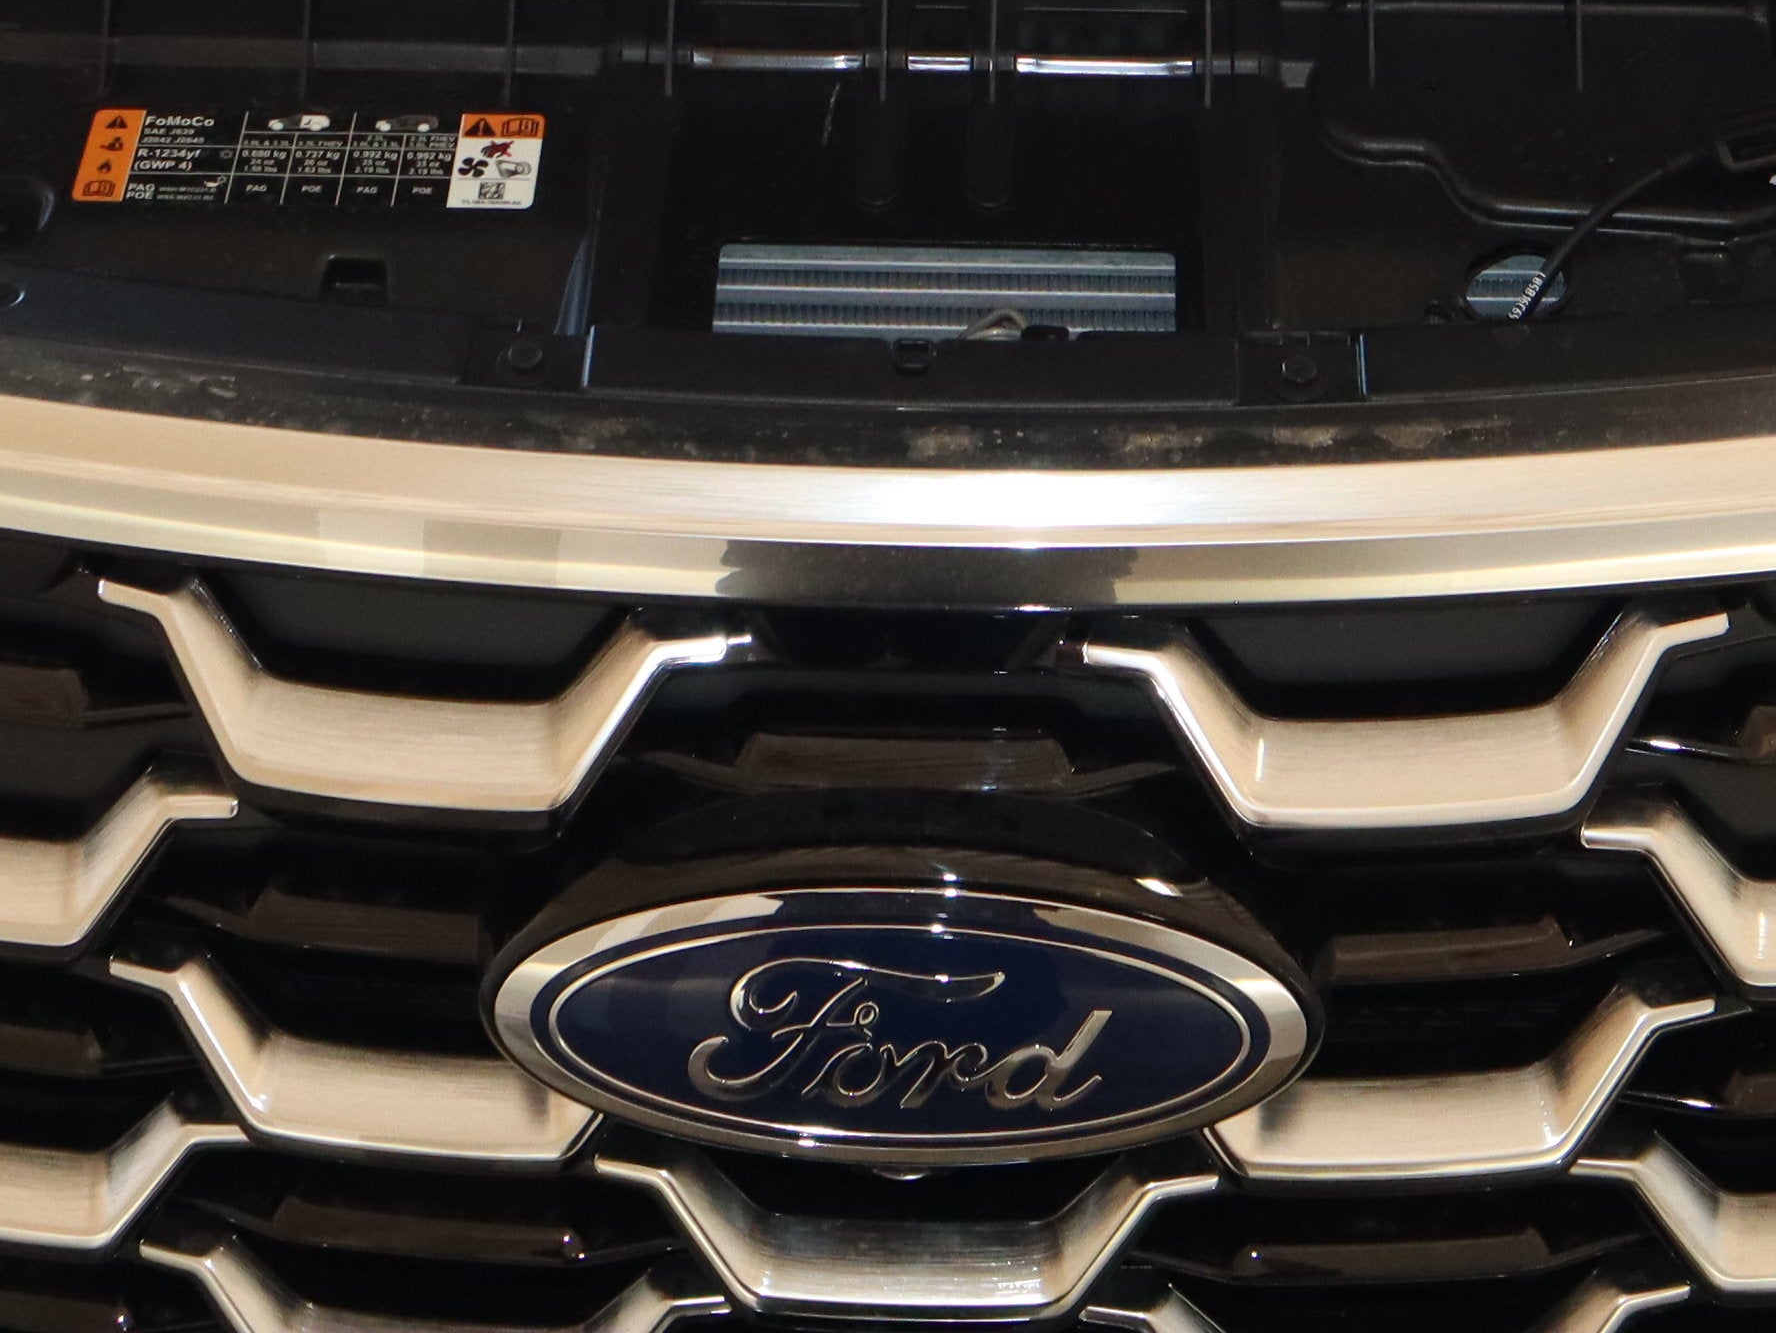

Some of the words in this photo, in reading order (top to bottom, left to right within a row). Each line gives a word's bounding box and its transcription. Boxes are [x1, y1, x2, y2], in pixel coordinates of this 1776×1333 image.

[144, 115, 215, 127] FoMoCo
[137, 148, 202, 160] R-1234yf
[273, 150, 287, 160] kg
[326, 151, 341, 161] kg
[384, 151, 398, 161] kg
[438, 152, 452, 162] kg
[134, 160, 176, 172] (GWP
[178, 161, 193, 172] 4)
[128, 183, 156, 192] PAG
[301, 184, 323, 193] POE
[412, 186, 434, 195] POE
[126, 191, 154, 200] POE
[687, 955, 1114, 1112] Ford
